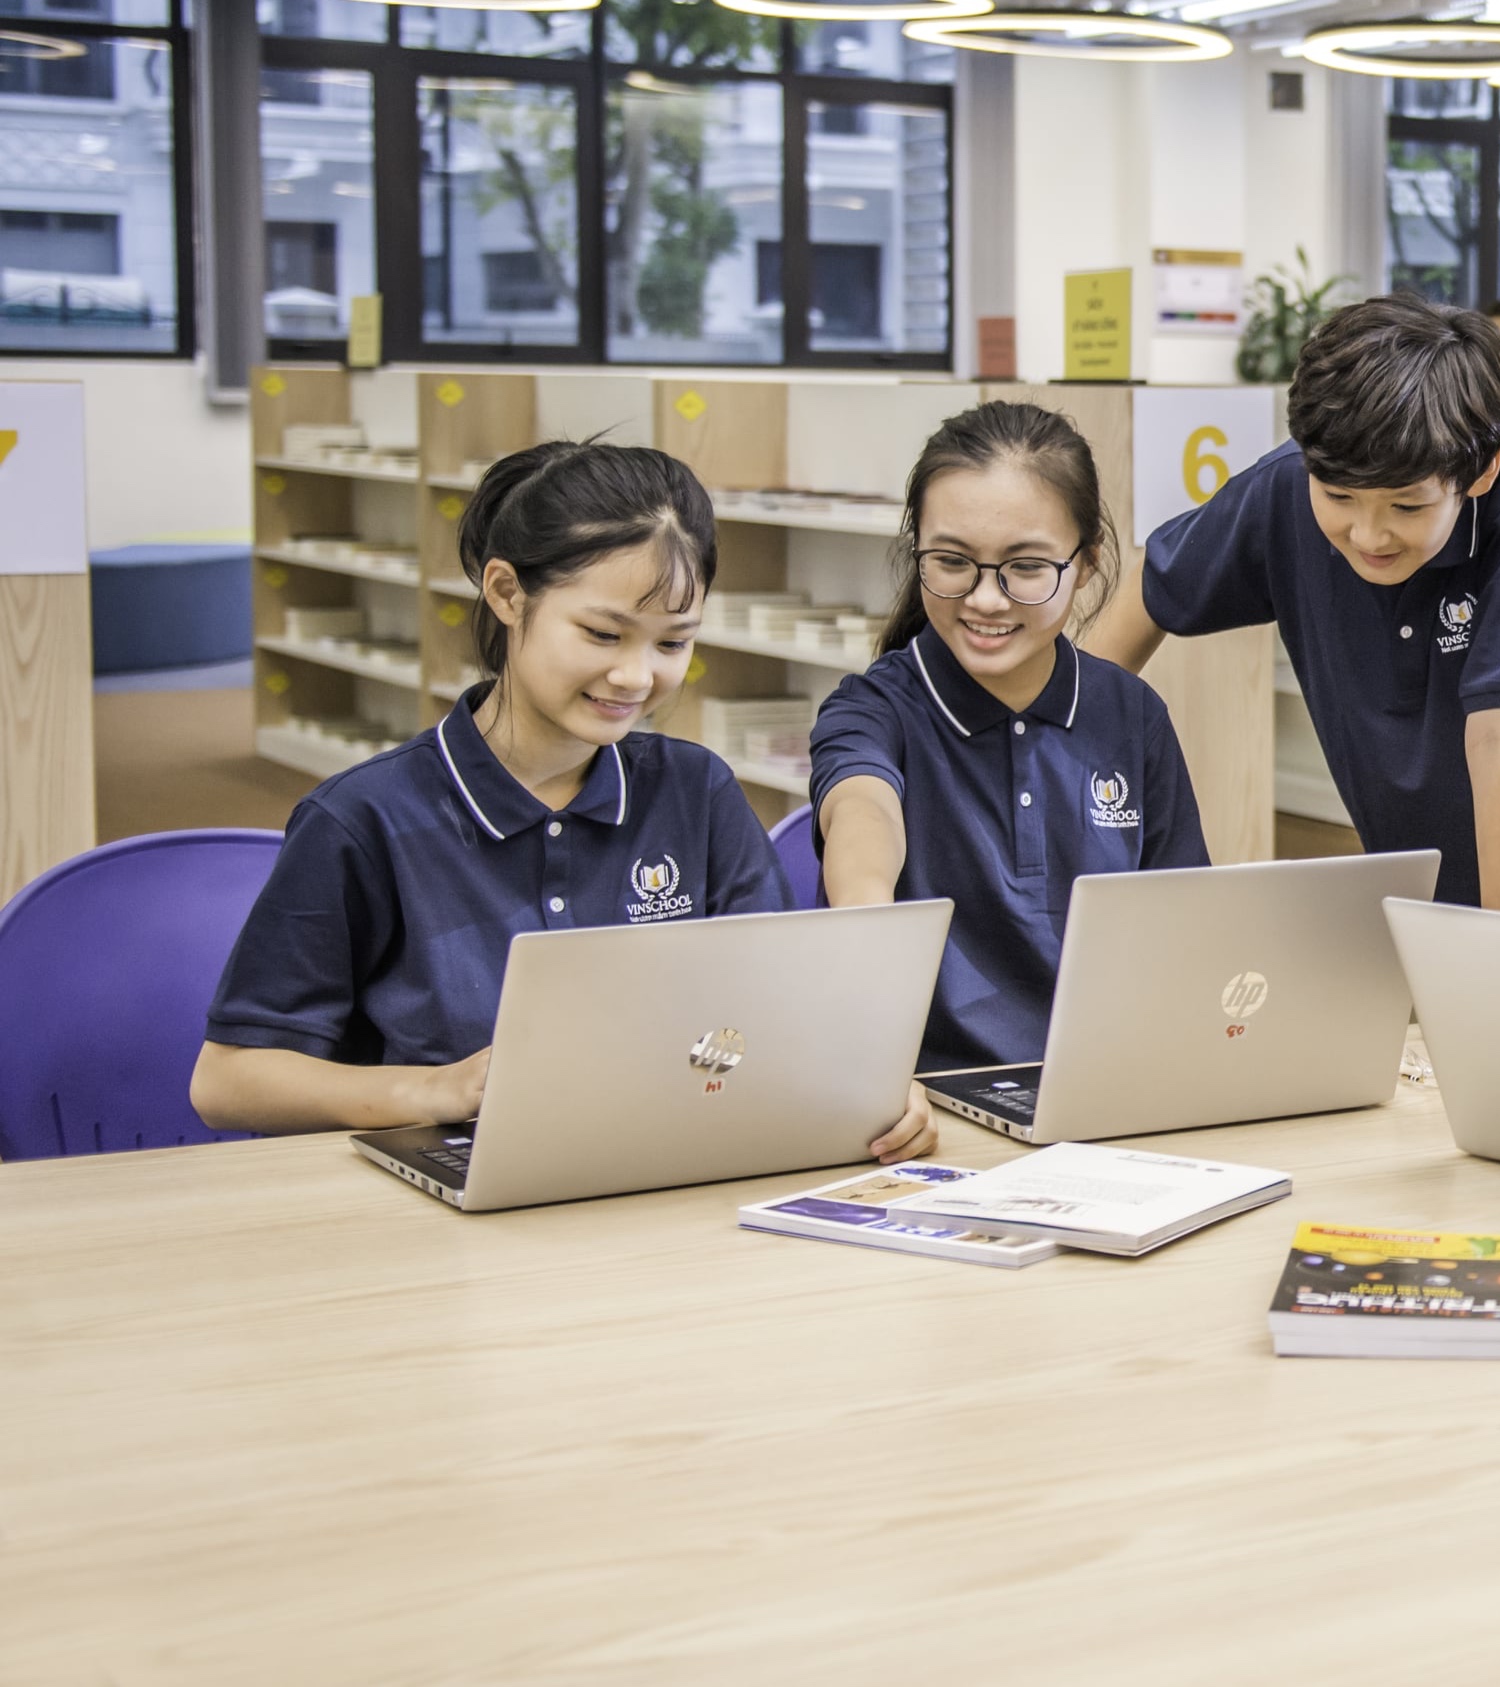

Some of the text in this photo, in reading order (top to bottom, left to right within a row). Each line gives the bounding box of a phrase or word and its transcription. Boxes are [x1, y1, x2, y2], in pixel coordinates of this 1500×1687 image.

[1183, 425, 1230, 505] 6
[1436, 631, 1470, 647] VINSC
[1089, 807, 1140, 821] VINSCHOOL
[626, 894, 692, 915] VINSCHOOL
[1221, 971, 1268, 1018] hp
[690, 1029, 744, 1074] hp
